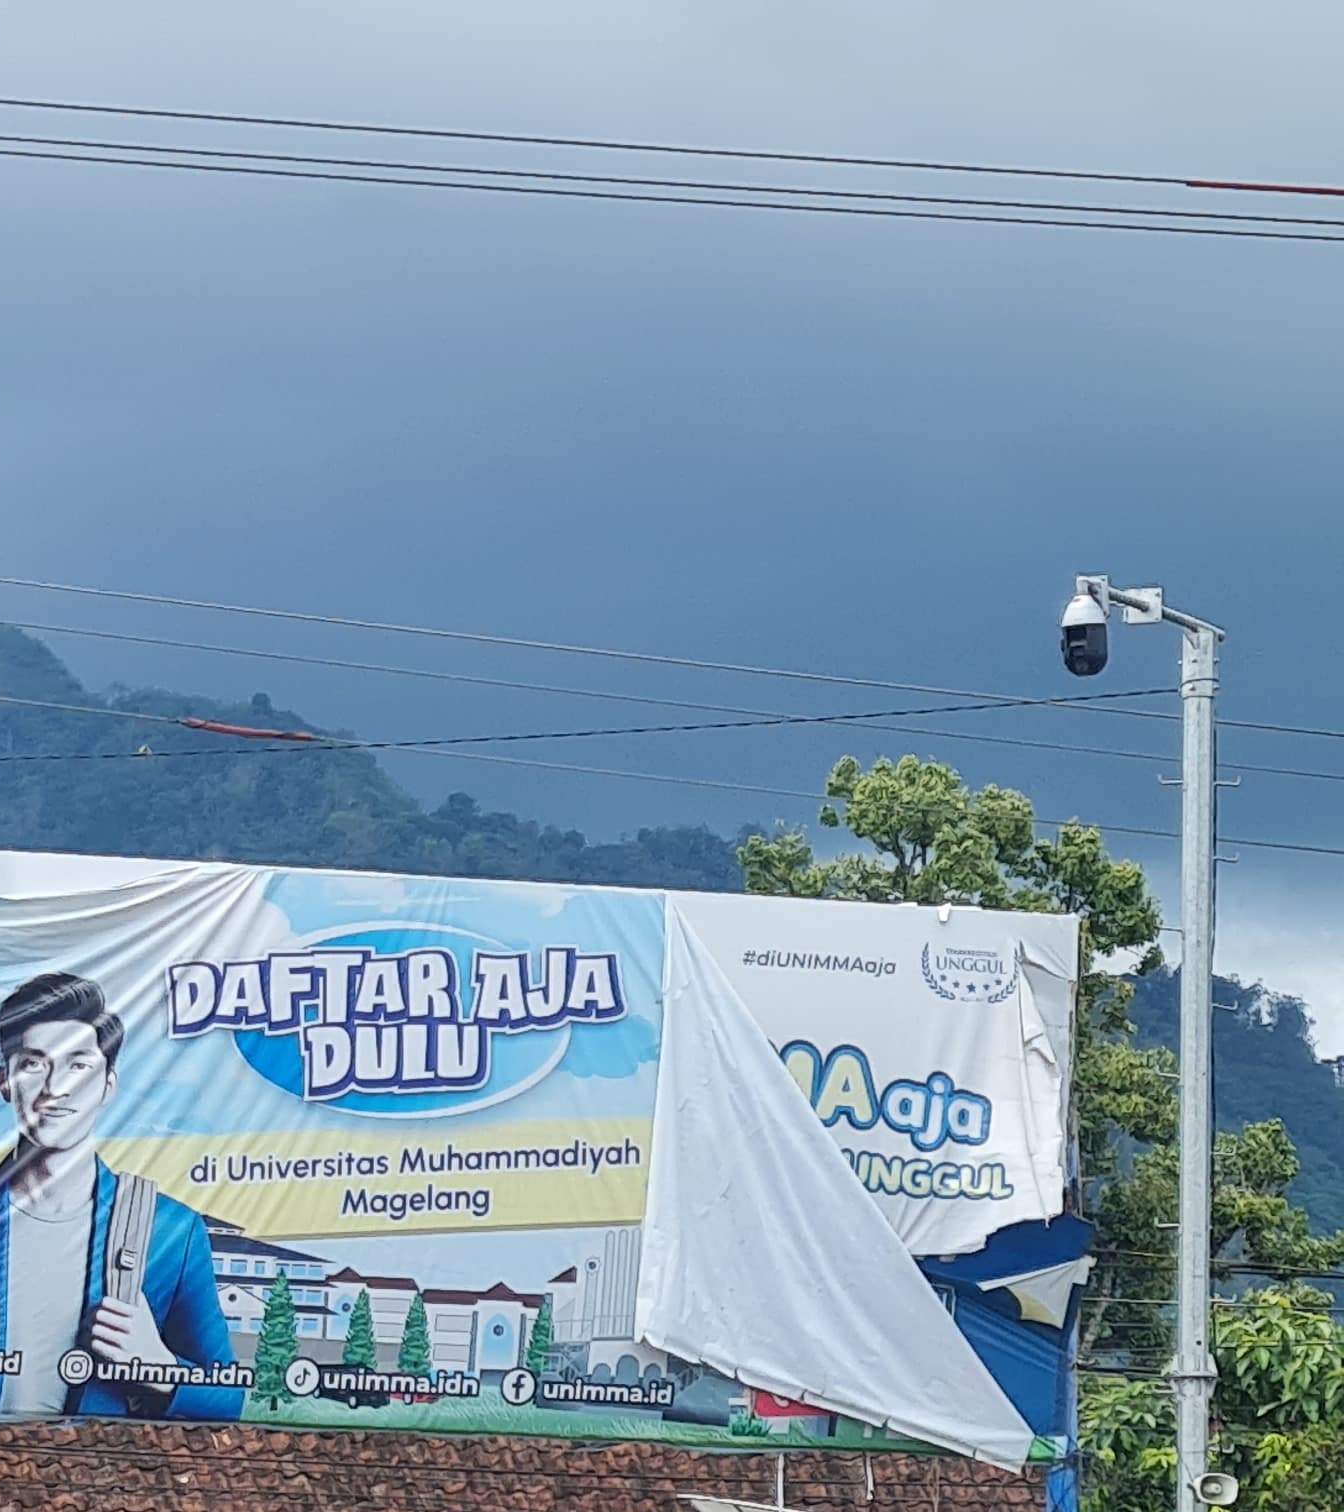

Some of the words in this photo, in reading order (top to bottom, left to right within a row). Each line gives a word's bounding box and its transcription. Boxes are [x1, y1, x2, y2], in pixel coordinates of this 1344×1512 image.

[742, 949, 897, 978] #diUNIMMAaja
[935, 955, 1008, 975] UNGGUL
[171, 949, 456, 1032] DAFTAR
[474, 947, 623, 1028] AJA
[305, 1022, 489, 1098] DULU
[880, 1072, 992, 1152] aja
[190, 1155, 217, 1183] di
[227, 1148, 390, 1182] Universitas
[400, 1139, 642, 1174] Muhammadiyah
[341, 1183, 491, 1220] Magelang
[97, 1359, 255, 1387] unimma.idn
[322, 1369, 480, 1397] unimma.idn
[542, 1380, 674, 1405] unimma.id
